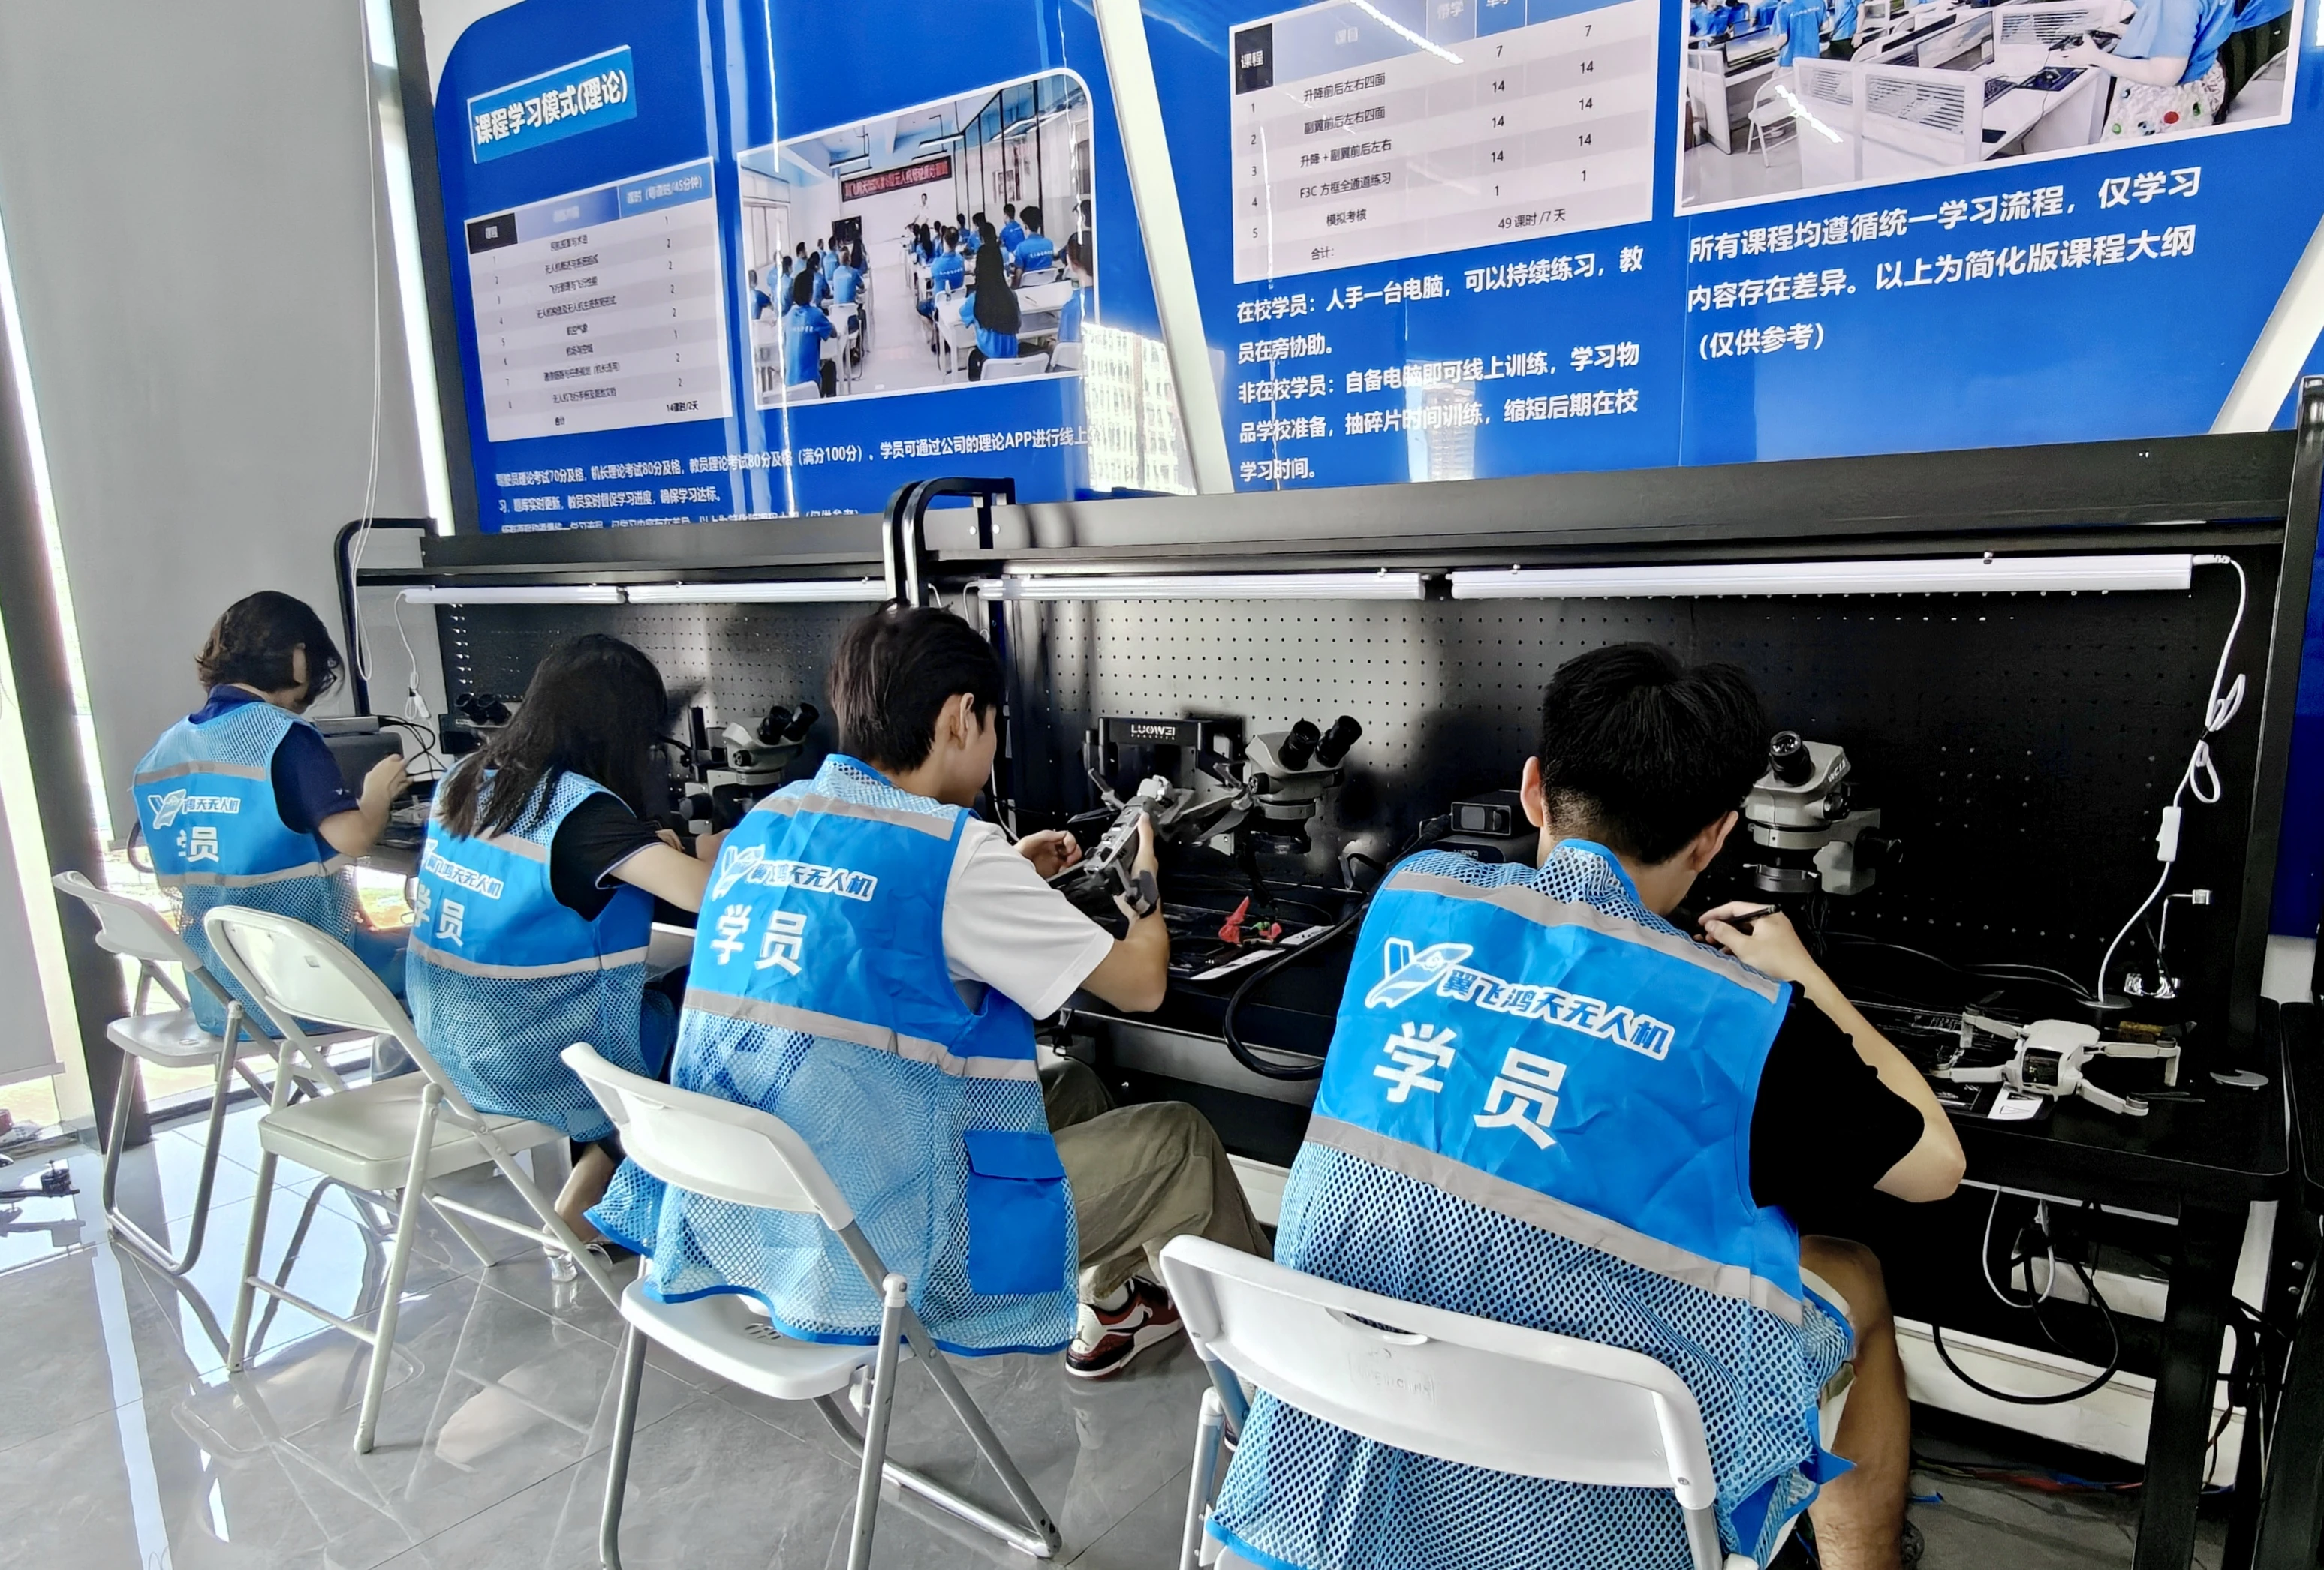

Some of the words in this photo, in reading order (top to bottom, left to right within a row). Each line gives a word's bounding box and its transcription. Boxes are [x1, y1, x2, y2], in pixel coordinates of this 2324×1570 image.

[1585, 25, 1592, 37] 7
[1240, 50, 1264, 69] 课程
[1496, 45, 1504, 57] 7
[1579, 60, 1594, 74] 14
[1303, 72, 1386, 102] 升降前后左右四面
[1492, 80, 1506, 94] 14
[1251, 102, 1255, 113] 1
[1579, 97, 1593, 111] 14
[1303, 106, 1386, 134] 副翼前后左右四面
[1492, 115, 1505, 128] 14
[1251, 134, 1257, 145] 2
[1578, 133, 1592, 147] 14
[1330, 138, 1392, 163] 副翼前后左右
[1491, 149, 1504, 164] 14
[1251, 166, 1257, 177] 3
[1581, 170, 1587, 182] 1
[1320, 171, 1392, 197] 方框全通道练习
[1495, 185, 1500, 197] 1
[1251, 197, 1258, 208] 4
[1326, 209, 1367, 227] 模拟考核
[1688, 166, 2202, 263] 所有课程均遵循统一学习流程，仅学习
[1252, 227, 1258, 239] 5
[1687, 224, 2196, 313] 内容存在差异。以上为简化版课程大纲
[1236, 245, 1644, 324] 在校学员：人手一台电脑，可以持续练习，教
[1238, 334, 1333, 365] 员在旁协助。
[1238, 341, 1640, 404] 非在校学员：自备电脑即可线上训练，学习物
[1239, 388, 1639, 444] 品学校准备，抽碎片时间训练，缩短后期在校
[1239, 457, 1316, 481] 学习时间。
[710, 904, 807, 976] 学员
[1438, 967, 1674, 1059] 翼飞鸿天无人机
[1373, 1021, 1567, 1150] 学员
